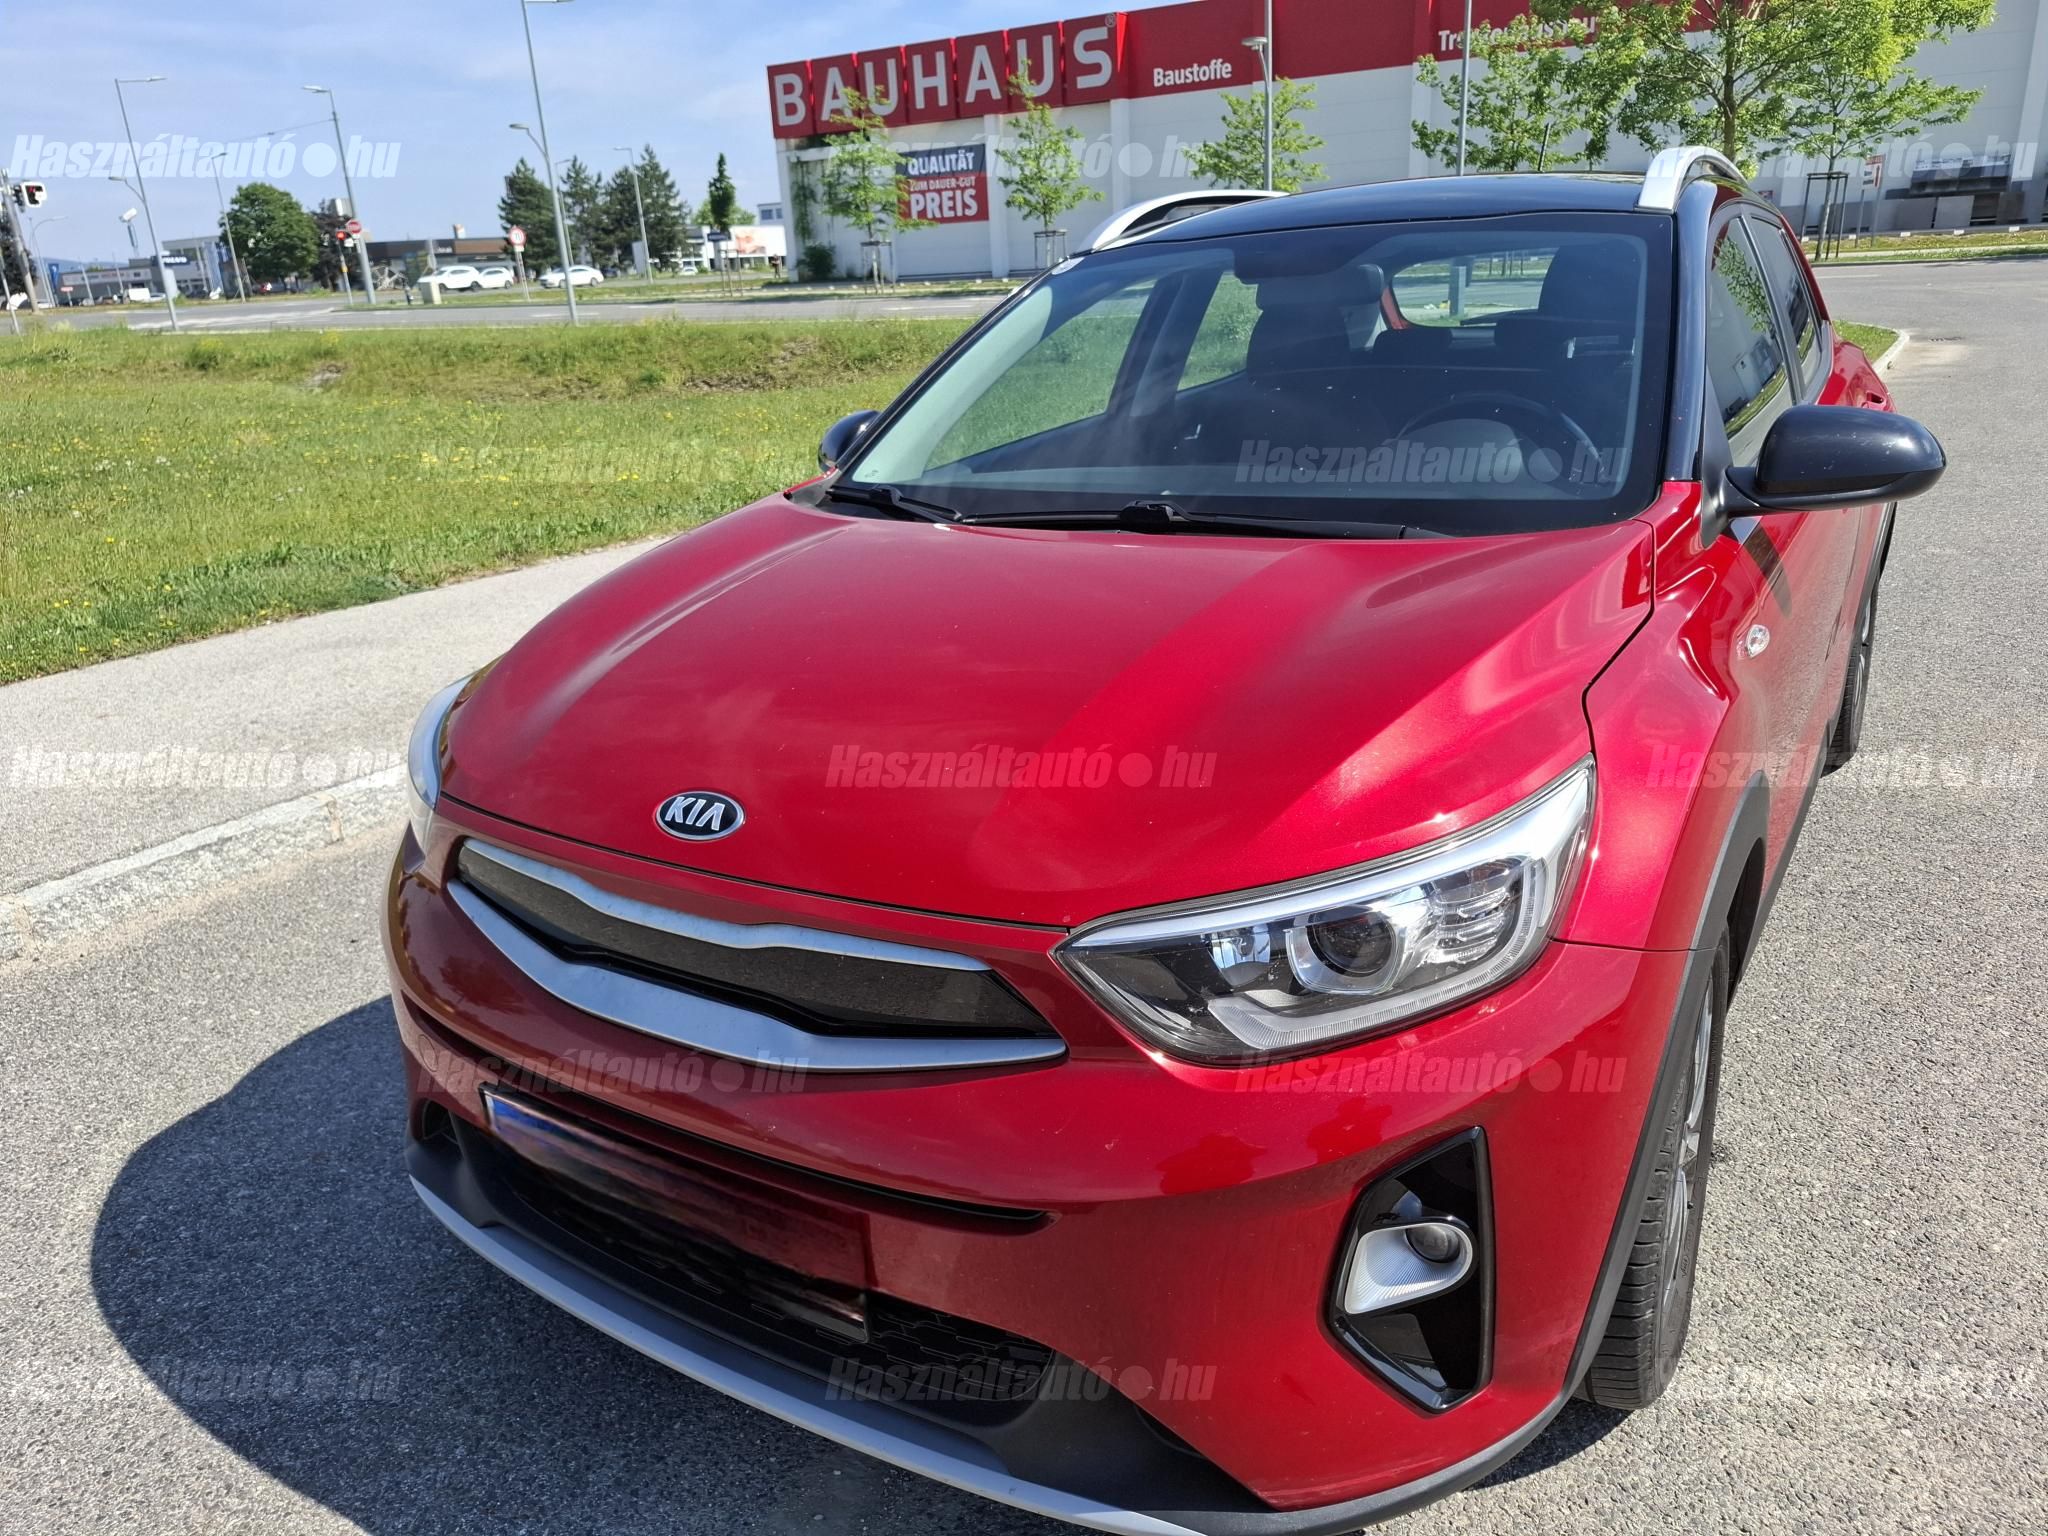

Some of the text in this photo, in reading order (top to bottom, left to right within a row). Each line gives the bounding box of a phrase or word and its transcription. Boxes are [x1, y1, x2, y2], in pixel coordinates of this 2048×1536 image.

[773, 26, 1113, 127] BAUHAUS
[1153, 58, 1232, 87] Baustoffe
[907, 150, 975, 175] QUALITÄT
[910, 188, 979, 219] PREIS
[664, 796, 726, 831] KIA
